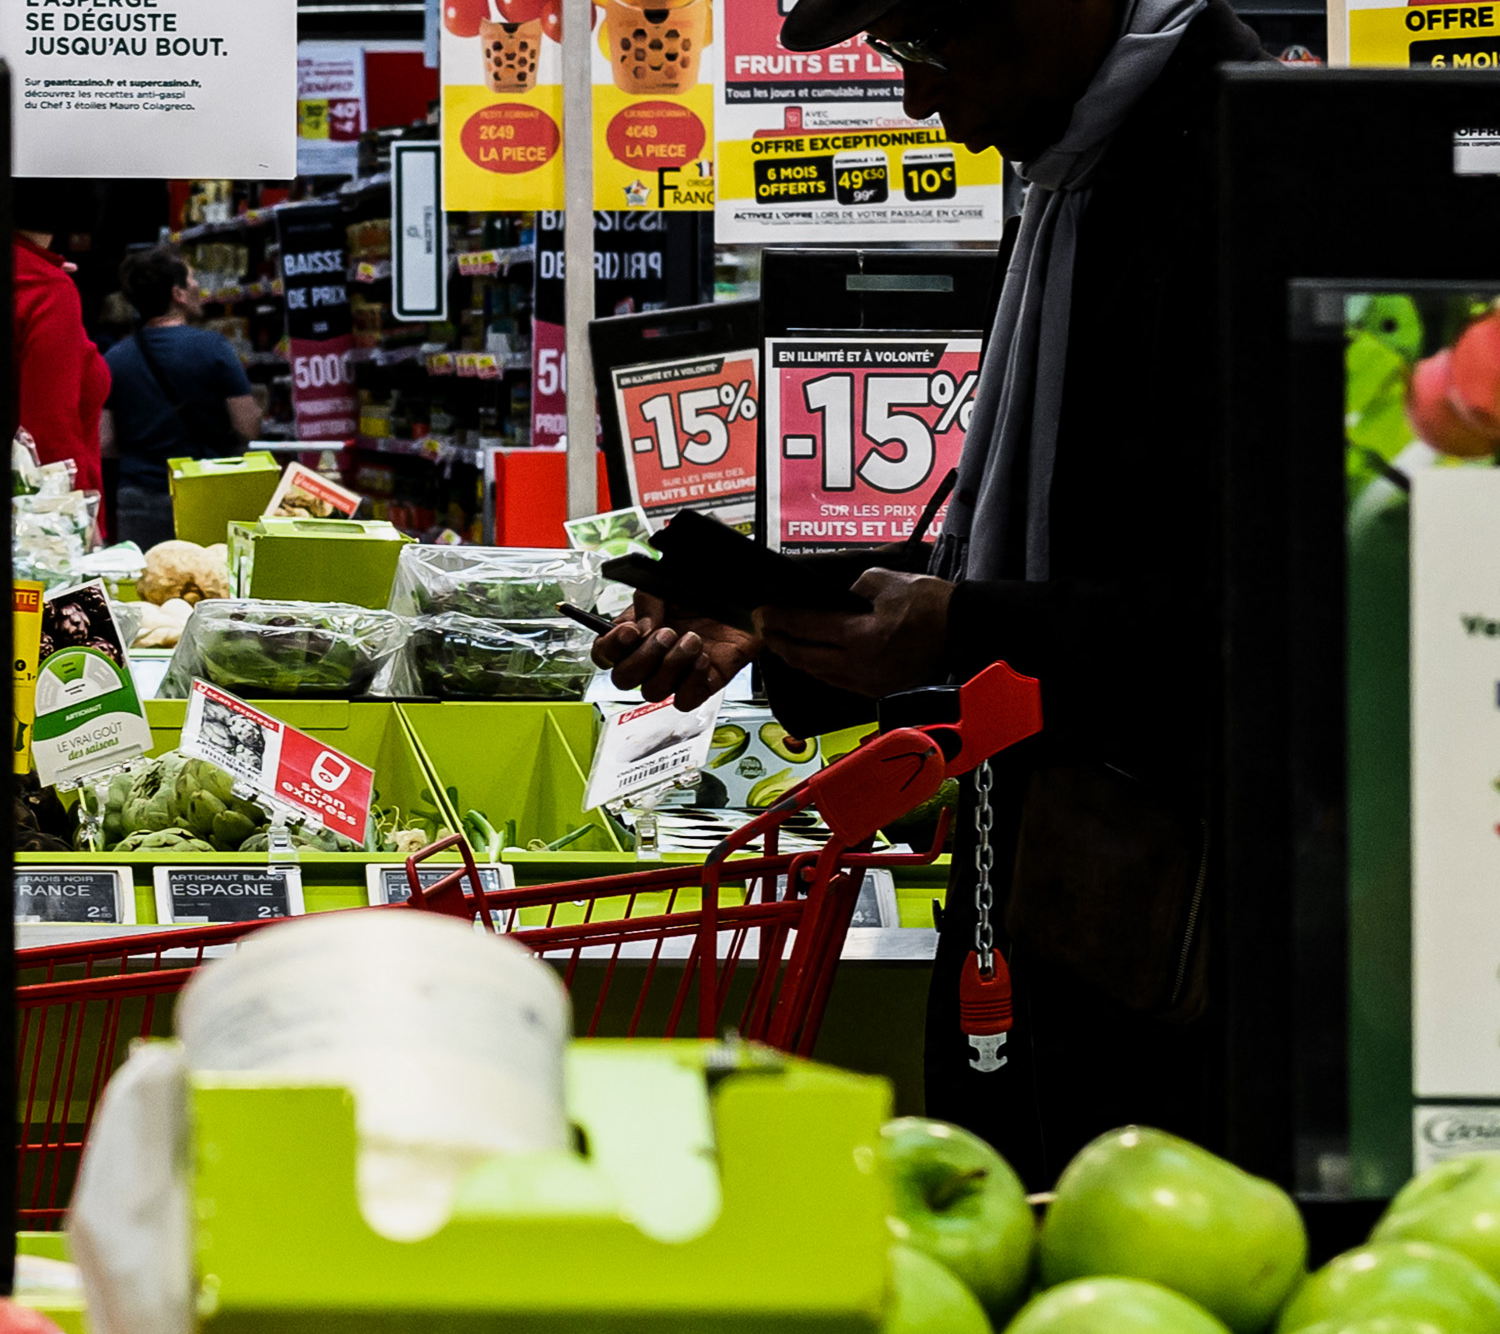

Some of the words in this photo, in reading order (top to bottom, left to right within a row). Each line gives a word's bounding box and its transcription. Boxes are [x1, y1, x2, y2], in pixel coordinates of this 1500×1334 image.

[26, 13, 54, 31] SE
[64, 9, 176, 31] DÉGUSTE
[26, 37, 146, 56] JUSQU'AU
[156, 38, 227, 56] BOUT.
[479, 147, 499, 161] LA
[503, 146, 547, 161] PIECE
[625, 144, 643, 158] LA
[646, 144, 687, 157] PIECE
[282, 781, 357, 826] express
[301, 781, 346, 810] scan
[173, 883, 274, 896] ESPAGNE
